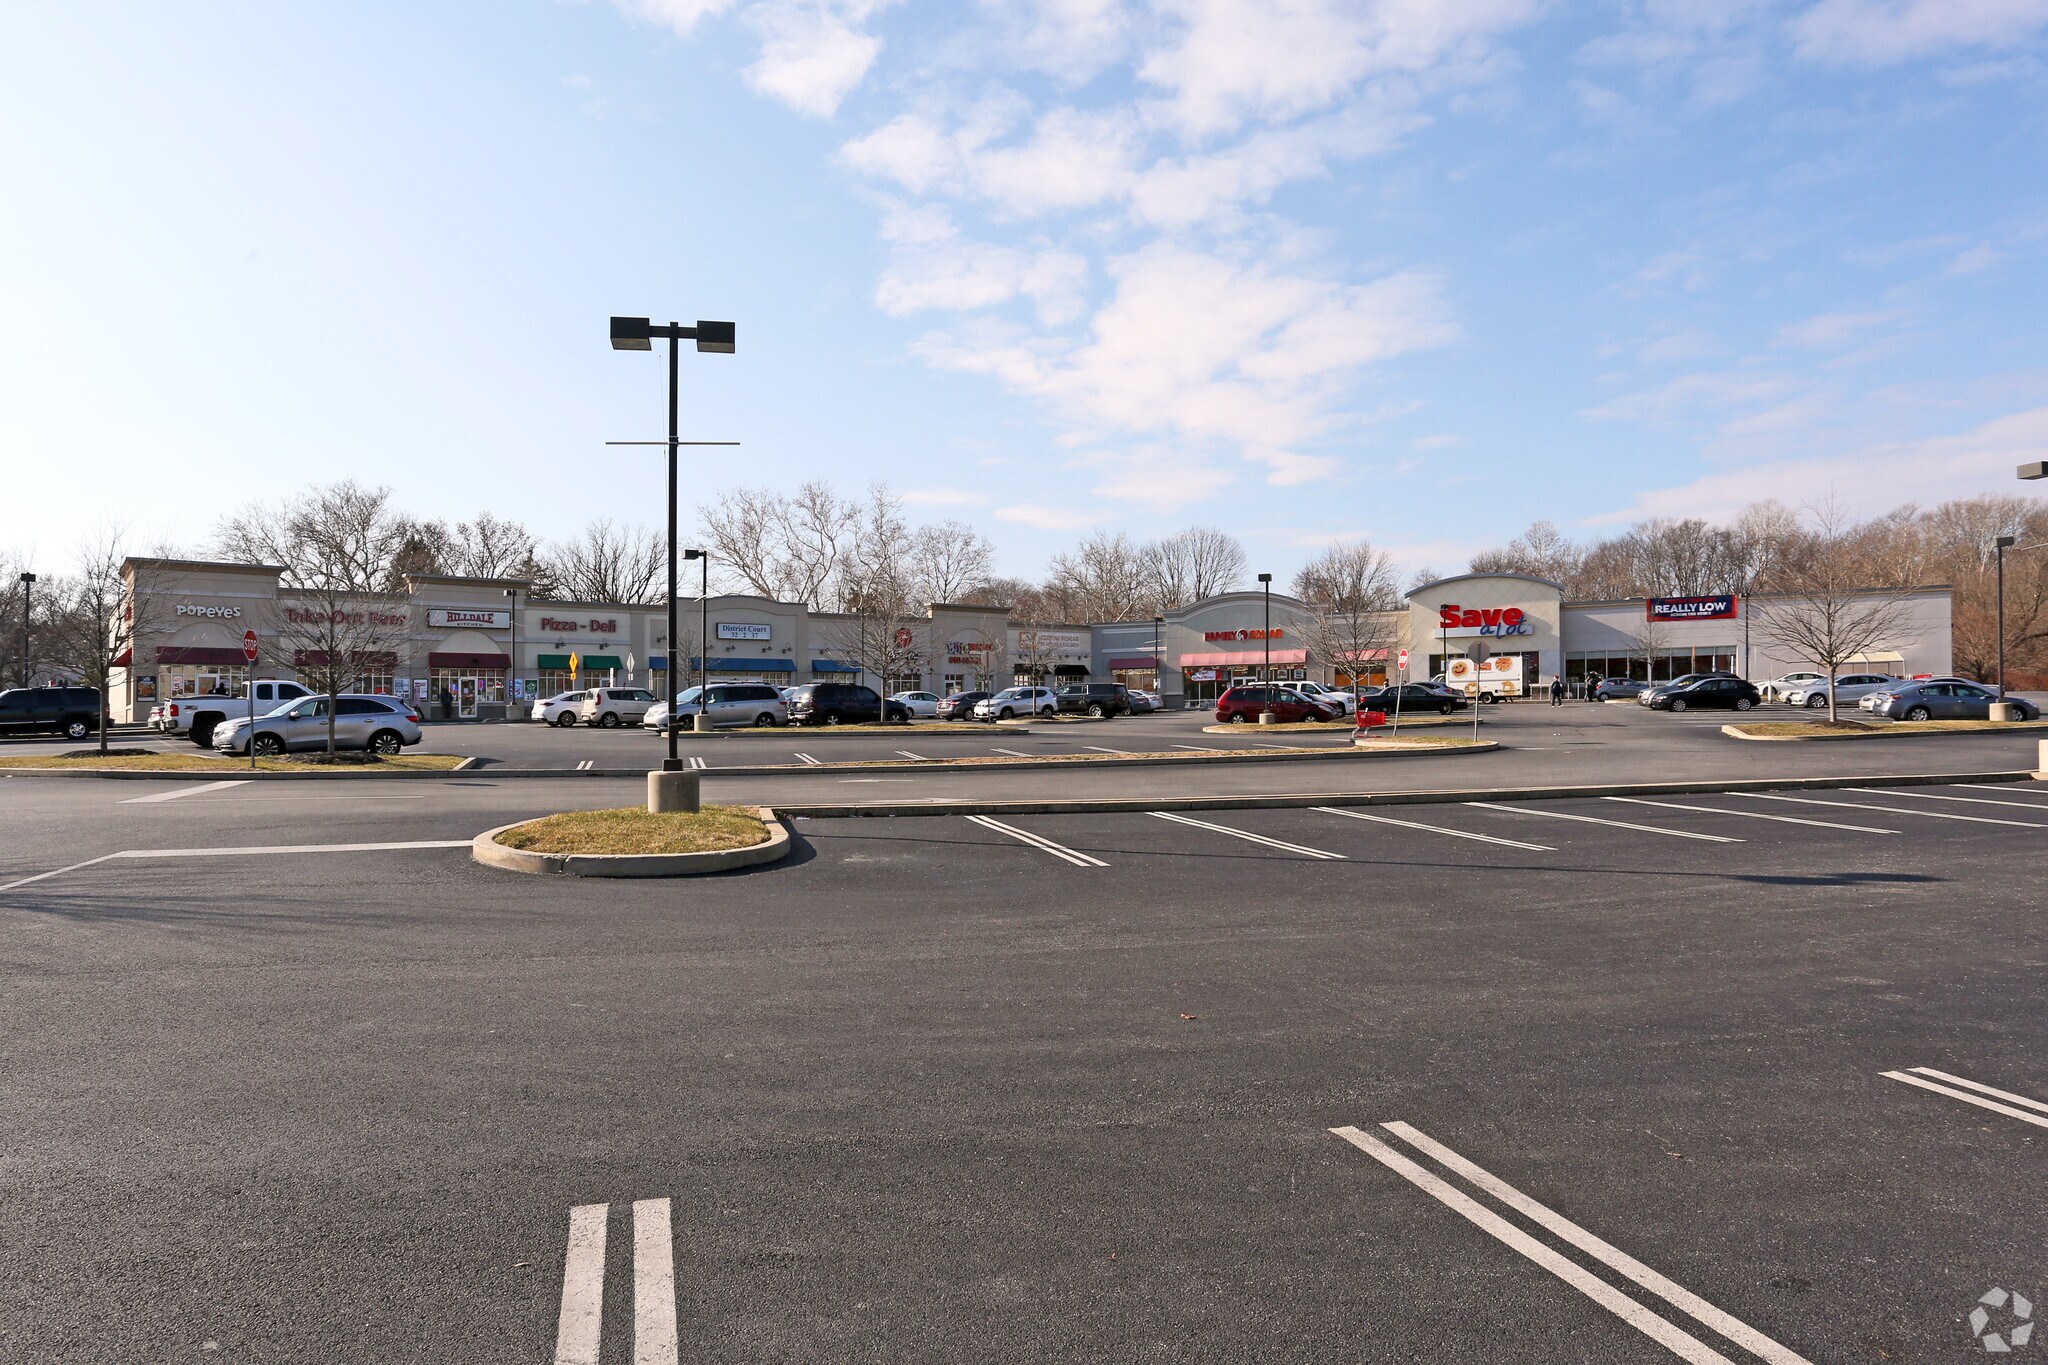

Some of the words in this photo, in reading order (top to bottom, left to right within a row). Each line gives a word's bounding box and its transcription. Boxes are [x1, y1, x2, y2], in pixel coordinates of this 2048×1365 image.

[1655, 603, 1697, 614] REALLY
[1699, 602, 1727, 612] LOW
[286, 608, 326, 623] Take
[332, 610, 365, 624] Out
[447, 611, 494, 624] HILLDALE
[1440, 604, 1523, 629] Save
[541, 617, 577, 632] Pizza
[590, 619, 616, 633] Deli
[1204, 630, 1237, 642] FAMILY
[244, 640, 257, 652] STOP
